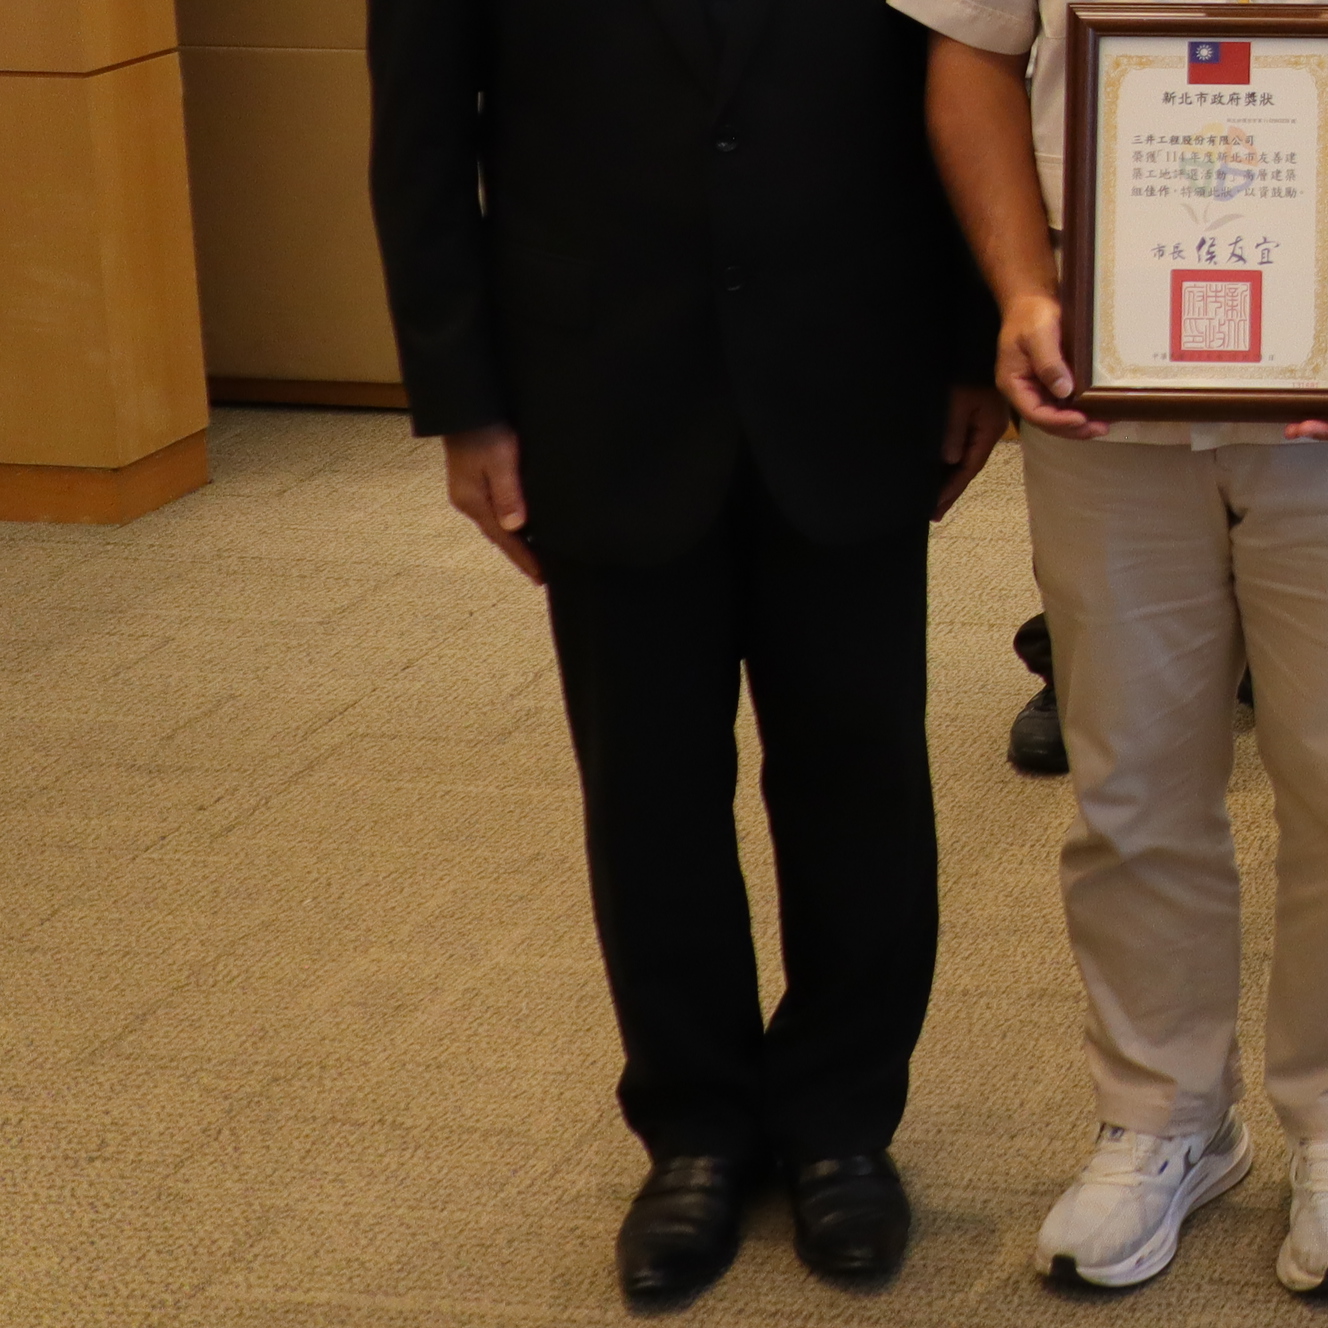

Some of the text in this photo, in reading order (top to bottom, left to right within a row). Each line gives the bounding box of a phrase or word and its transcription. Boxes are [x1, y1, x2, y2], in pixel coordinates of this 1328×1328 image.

[1161, 90, 1276, 108] 新北市政府獎狀
[1131, 134, 1256, 147] 三井工程股份有限公司
[1150, 235, 1281, 266] 市長 侯友宜
